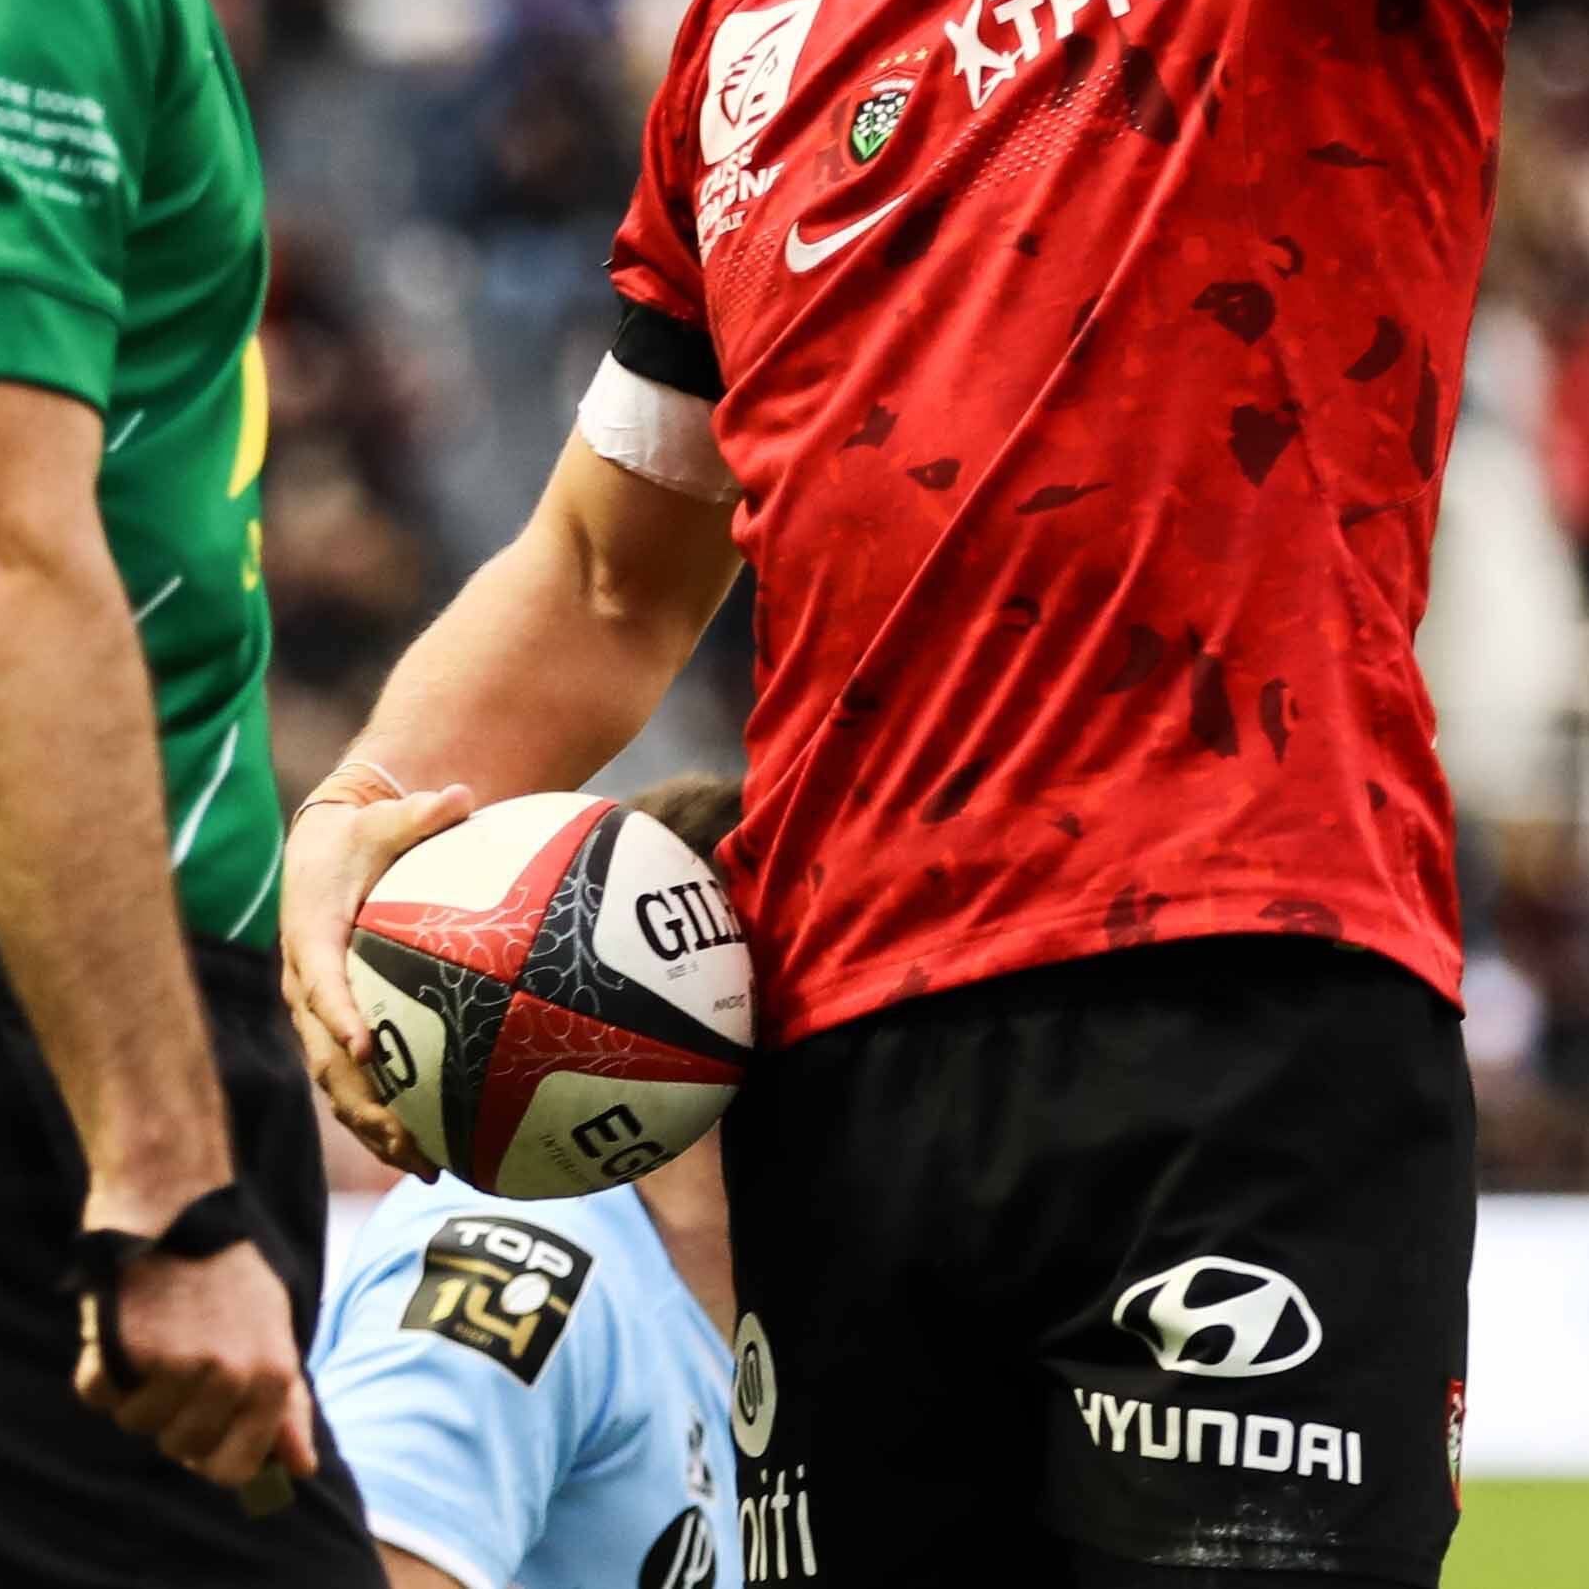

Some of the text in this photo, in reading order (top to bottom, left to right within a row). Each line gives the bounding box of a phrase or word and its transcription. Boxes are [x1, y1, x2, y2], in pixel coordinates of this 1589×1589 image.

[453, 1220, 574, 1279] TOP
[427, 1277, 542, 1358] 14
[1073, 1387, 1362, 1486] HYUNDAI
